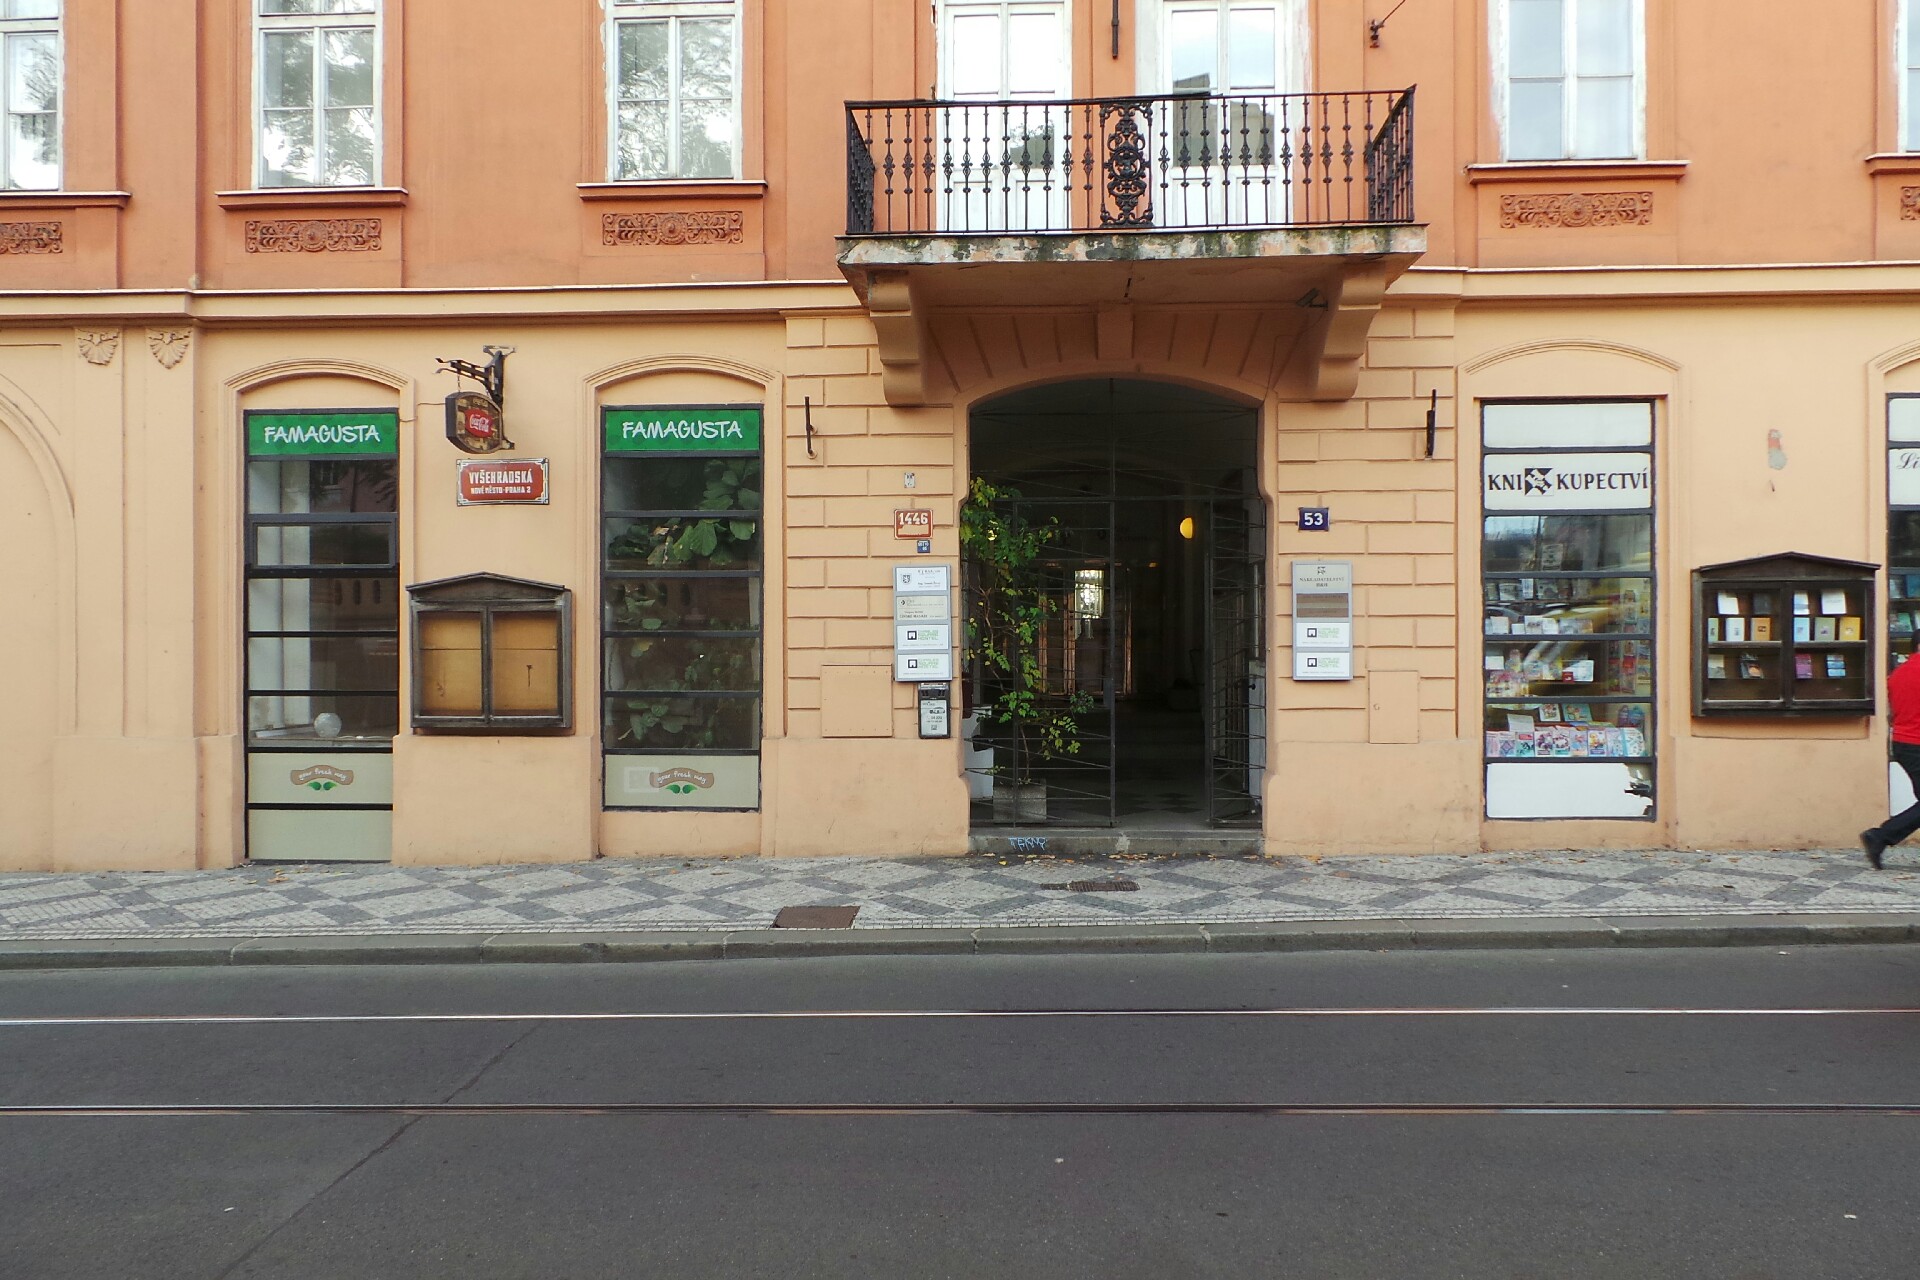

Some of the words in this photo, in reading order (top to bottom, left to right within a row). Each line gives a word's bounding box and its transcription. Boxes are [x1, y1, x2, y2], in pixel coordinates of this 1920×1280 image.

[264, 424, 381, 444] FAMAGUSTA
[622, 420, 743, 439] FAMAGUSTA
[1896, 451, 1920, 469] Li
[469, 469, 533, 484] VYŠEHRADSKÁ
[1488, 474, 1522, 491] KNI
[1557, 467, 1648, 490] KUPECTVÍ
[471, 486, 485, 494] NOVÉ
[899, 512, 928, 525] 1446
[1304, 512, 1324, 526] 53
